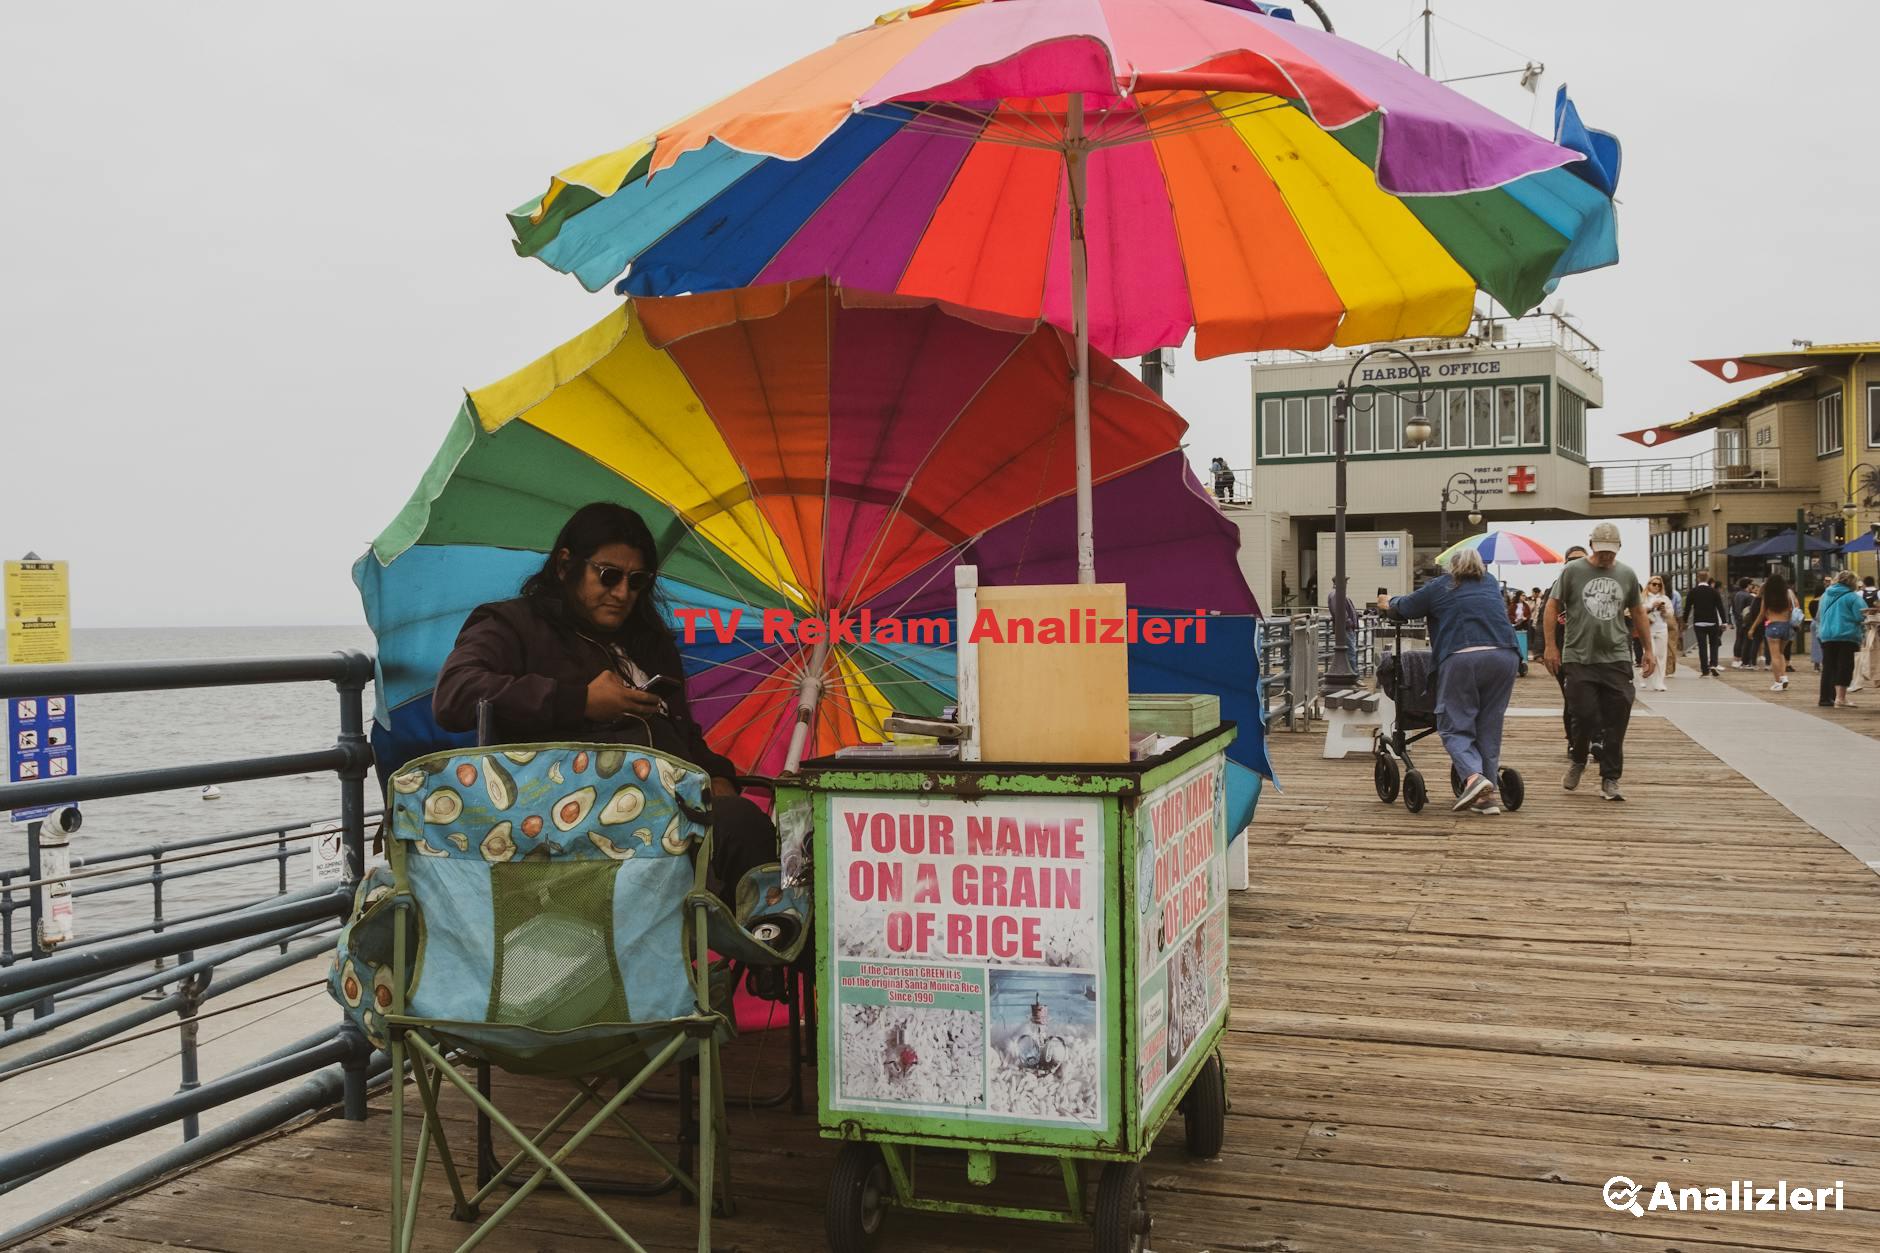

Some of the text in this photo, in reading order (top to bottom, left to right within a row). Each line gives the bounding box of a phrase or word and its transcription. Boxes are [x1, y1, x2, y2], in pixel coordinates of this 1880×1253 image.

[1362, 361, 1500, 380] HARBOR OFFICE
[1151, 772, 1213, 850] YOUR NAME
[844, 812, 1085, 859] YOUR NAME
[1155, 817, 1213, 903] ON A GRAIN
[849, 860, 1081, 909] ON A GRAIN
[1165, 893, 1179, 944] OF
[1182, 869, 1207, 929] RICE
[887, 911, 1042, 959] OF RICE
[842, 977, 855, 986] not
[856, 977, 870, 987] the
[871, 978, 903, 990] original
[904, 979, 928, 990] Santa
[929, 980, 960, 992] Monica
[860, 965, 961, 980] If the Cart isn't GREEN it is
[889, 991, 934, 1003] Since 1990
